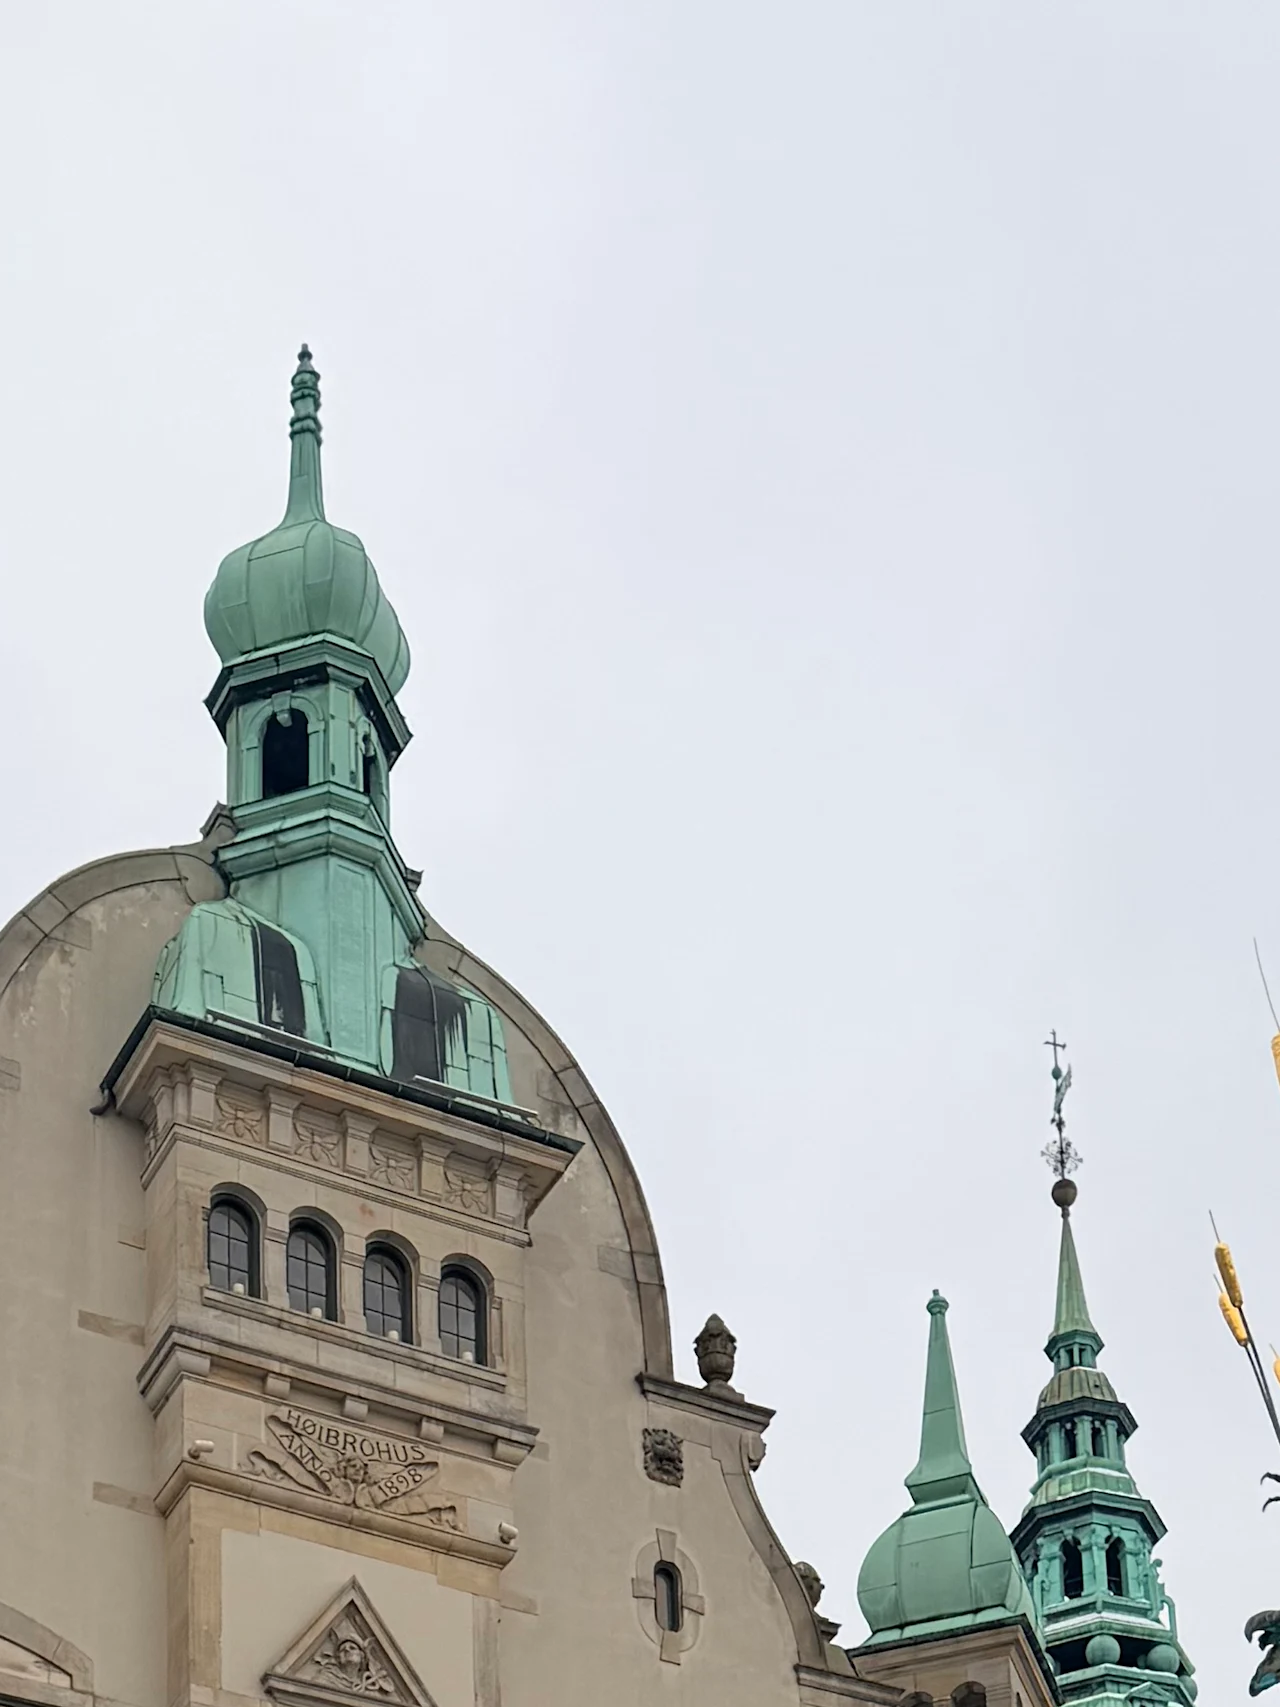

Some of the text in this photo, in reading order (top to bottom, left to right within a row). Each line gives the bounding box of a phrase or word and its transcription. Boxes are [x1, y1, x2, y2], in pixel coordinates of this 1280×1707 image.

[287, 1410, 425, 1462] HØIBROHUS
[280, 1433, 423, 1498] ANNO 1898
